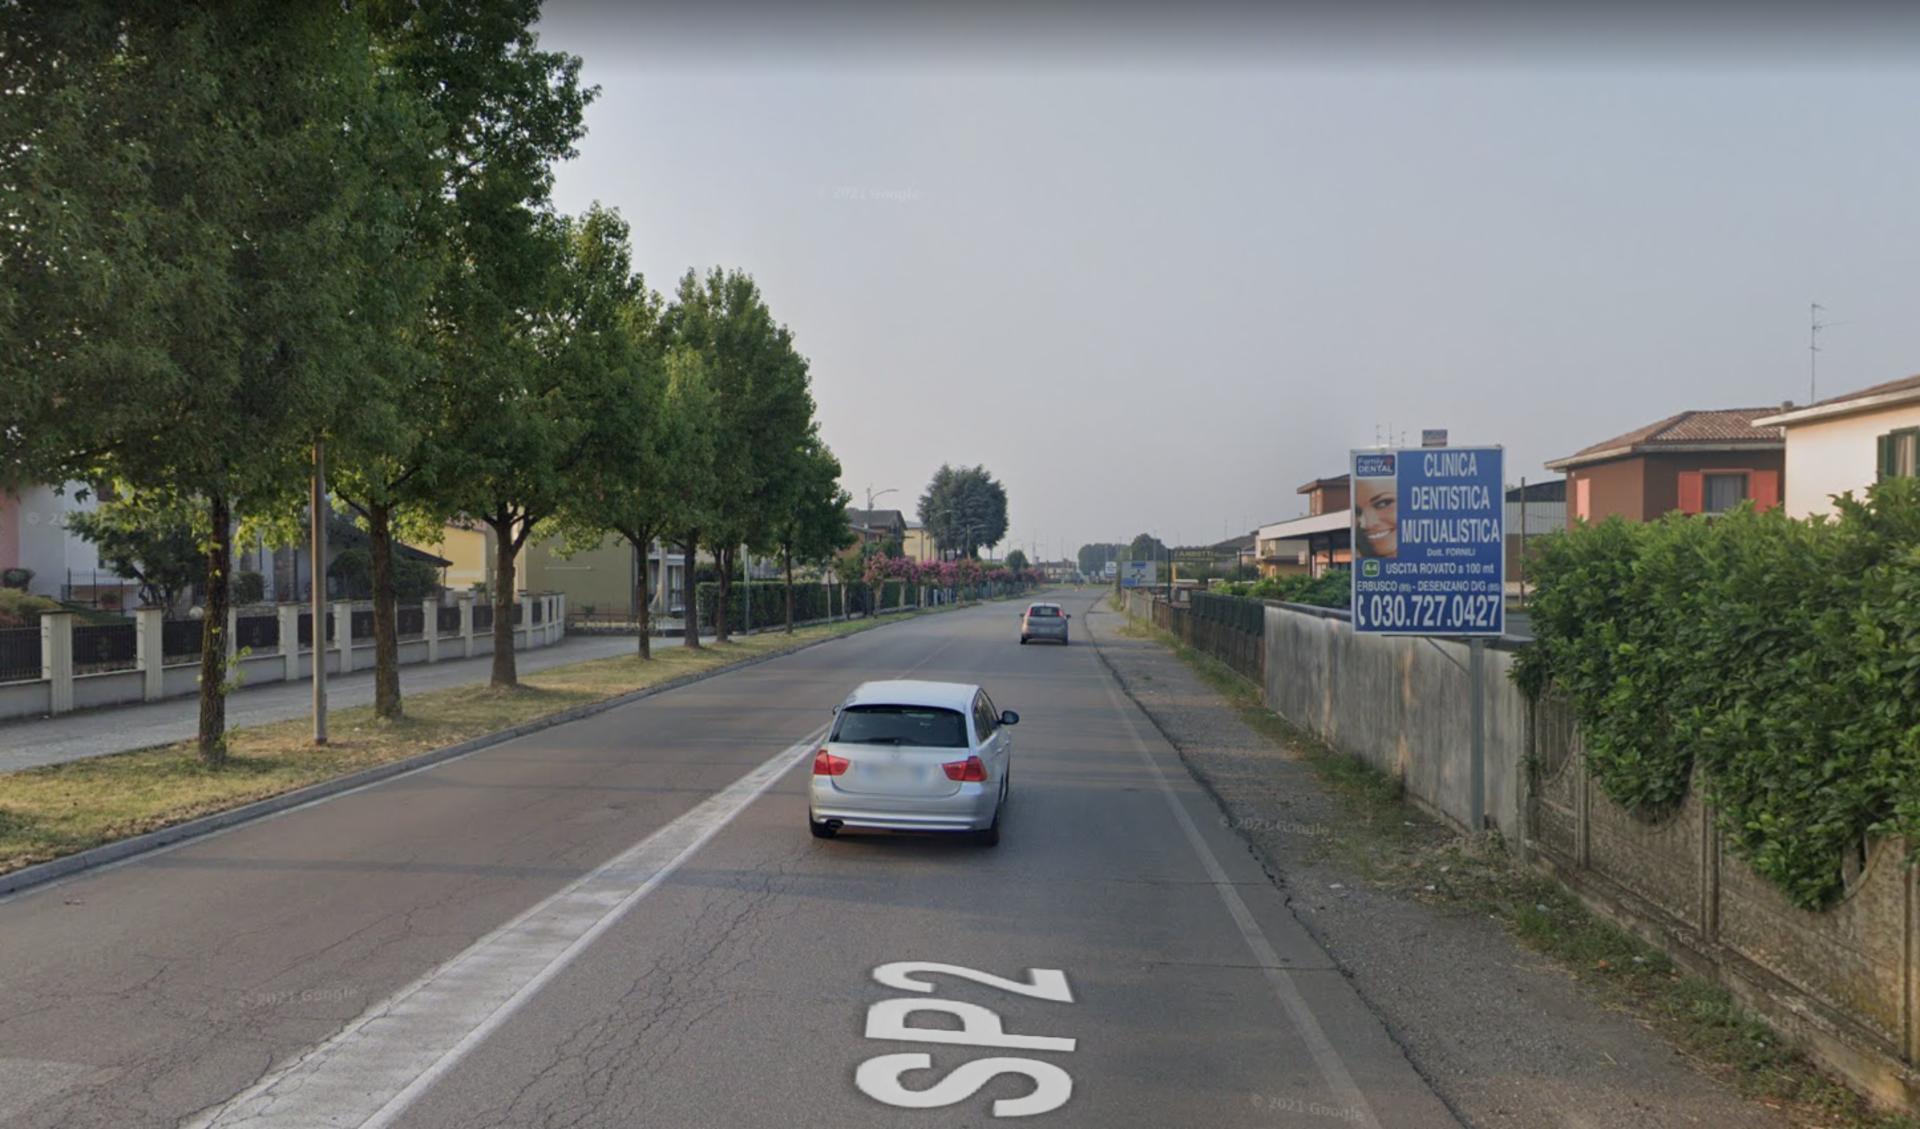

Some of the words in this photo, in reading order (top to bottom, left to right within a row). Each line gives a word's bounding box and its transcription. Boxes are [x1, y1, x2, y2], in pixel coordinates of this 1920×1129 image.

[1358, 465, 1393, 473] DENTAL
[1424, 452, 1478, 477] CLINICA
[1411, 485, 1491, 511] DENTISTICA
[1402, 519, 1500, 544] MUTUALISTICA
[1385, 563, 1418, 575] USCITA
[1419, 563, 1457, 574] ROVATO
[1458, 565, 1464, 575] a
[1466, 563, 1481, 575] 100
[1357, 581, 1397, 592] ERBUSCO
[1417, 581, 1469, 592] DESENZANO
[1371, 594, 1500, 627] 030.727.0427
